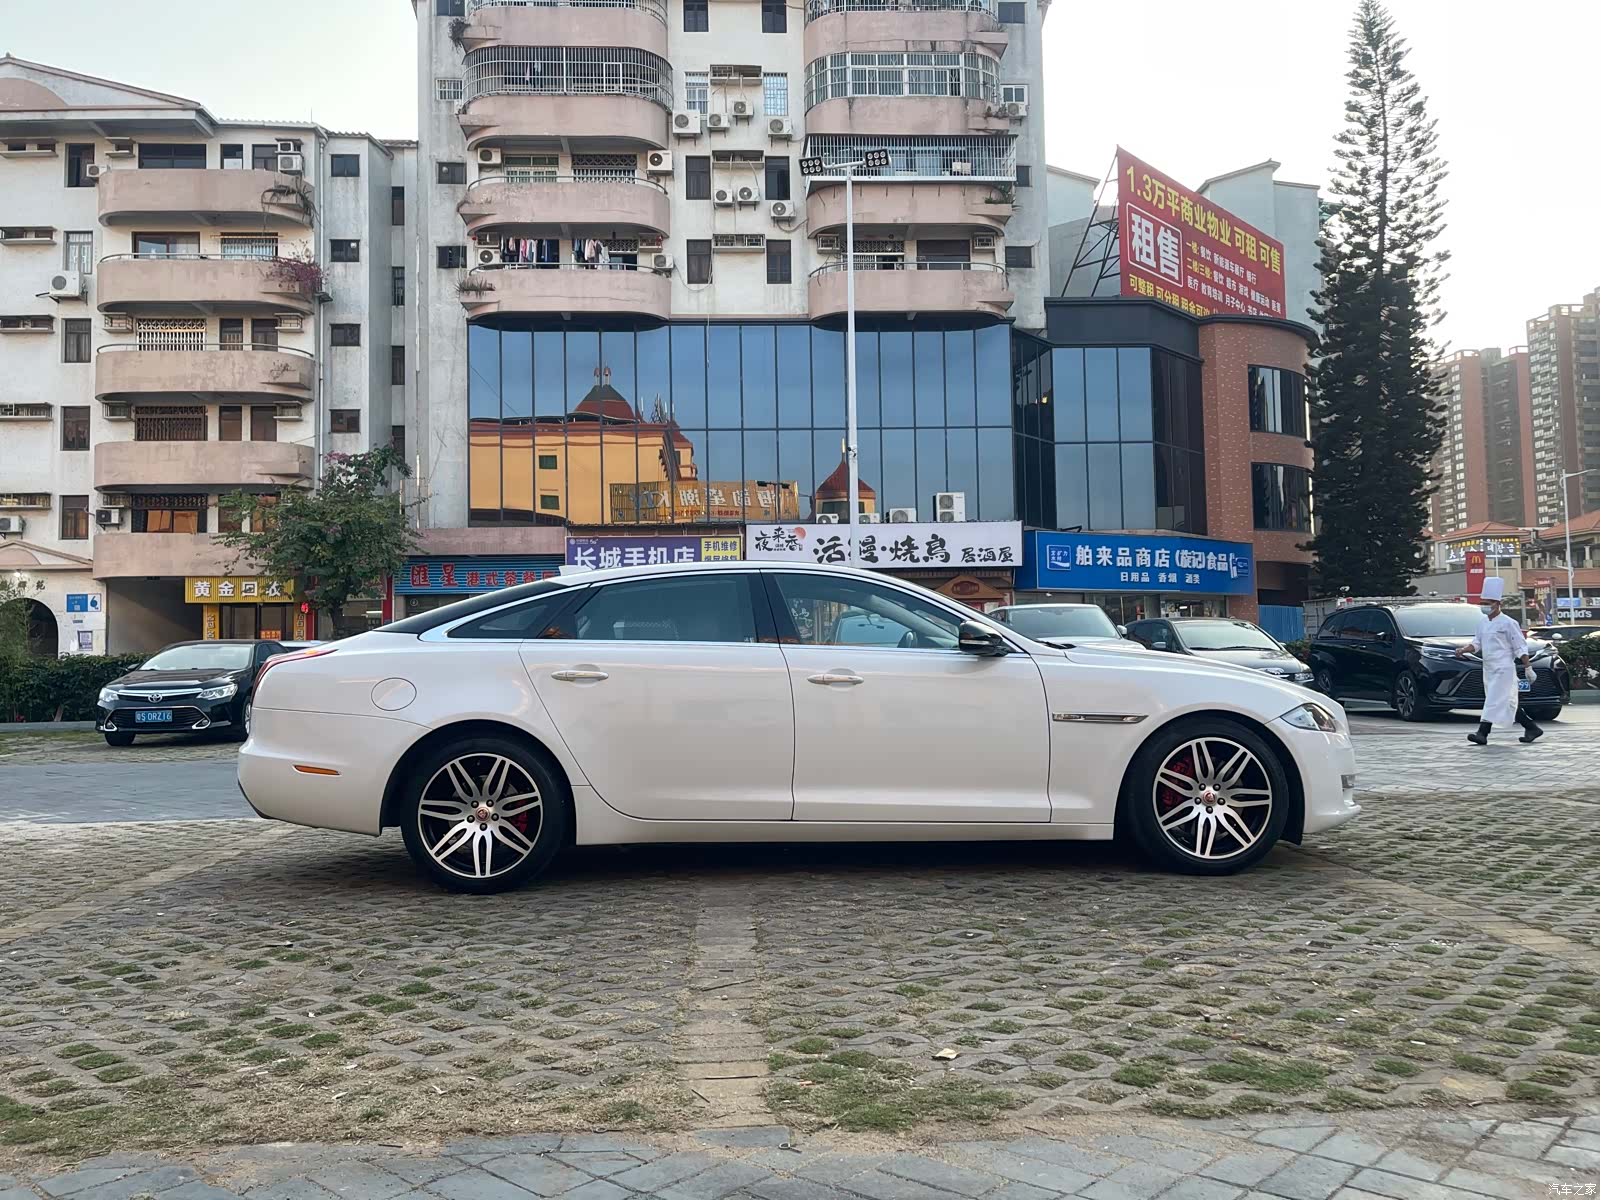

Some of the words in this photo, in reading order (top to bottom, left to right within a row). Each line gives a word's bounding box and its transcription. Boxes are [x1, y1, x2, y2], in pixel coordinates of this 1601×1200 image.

[1126, 166, 1231, 247] 1.3万平商业物业
[1233, 226, 1257, 261] 可租
[1259, 241, 1280, 275] 可售
[1131, 212, 1180, 281] 租售
[1129, 273, 1154, 297] 可整租
[1156, 286, 1180, 307] 可分租
[1225, 293, 1246, 313] 月子中心
[704, 540, 738, 552] 手机维修
[961, 546, 1014, 563] 居酒屋
[1120, 572, 1150, 583] 日用品
[1158, 572, 1177, 583] 香烟
[194, 581, 282, 597] 黄金回收
